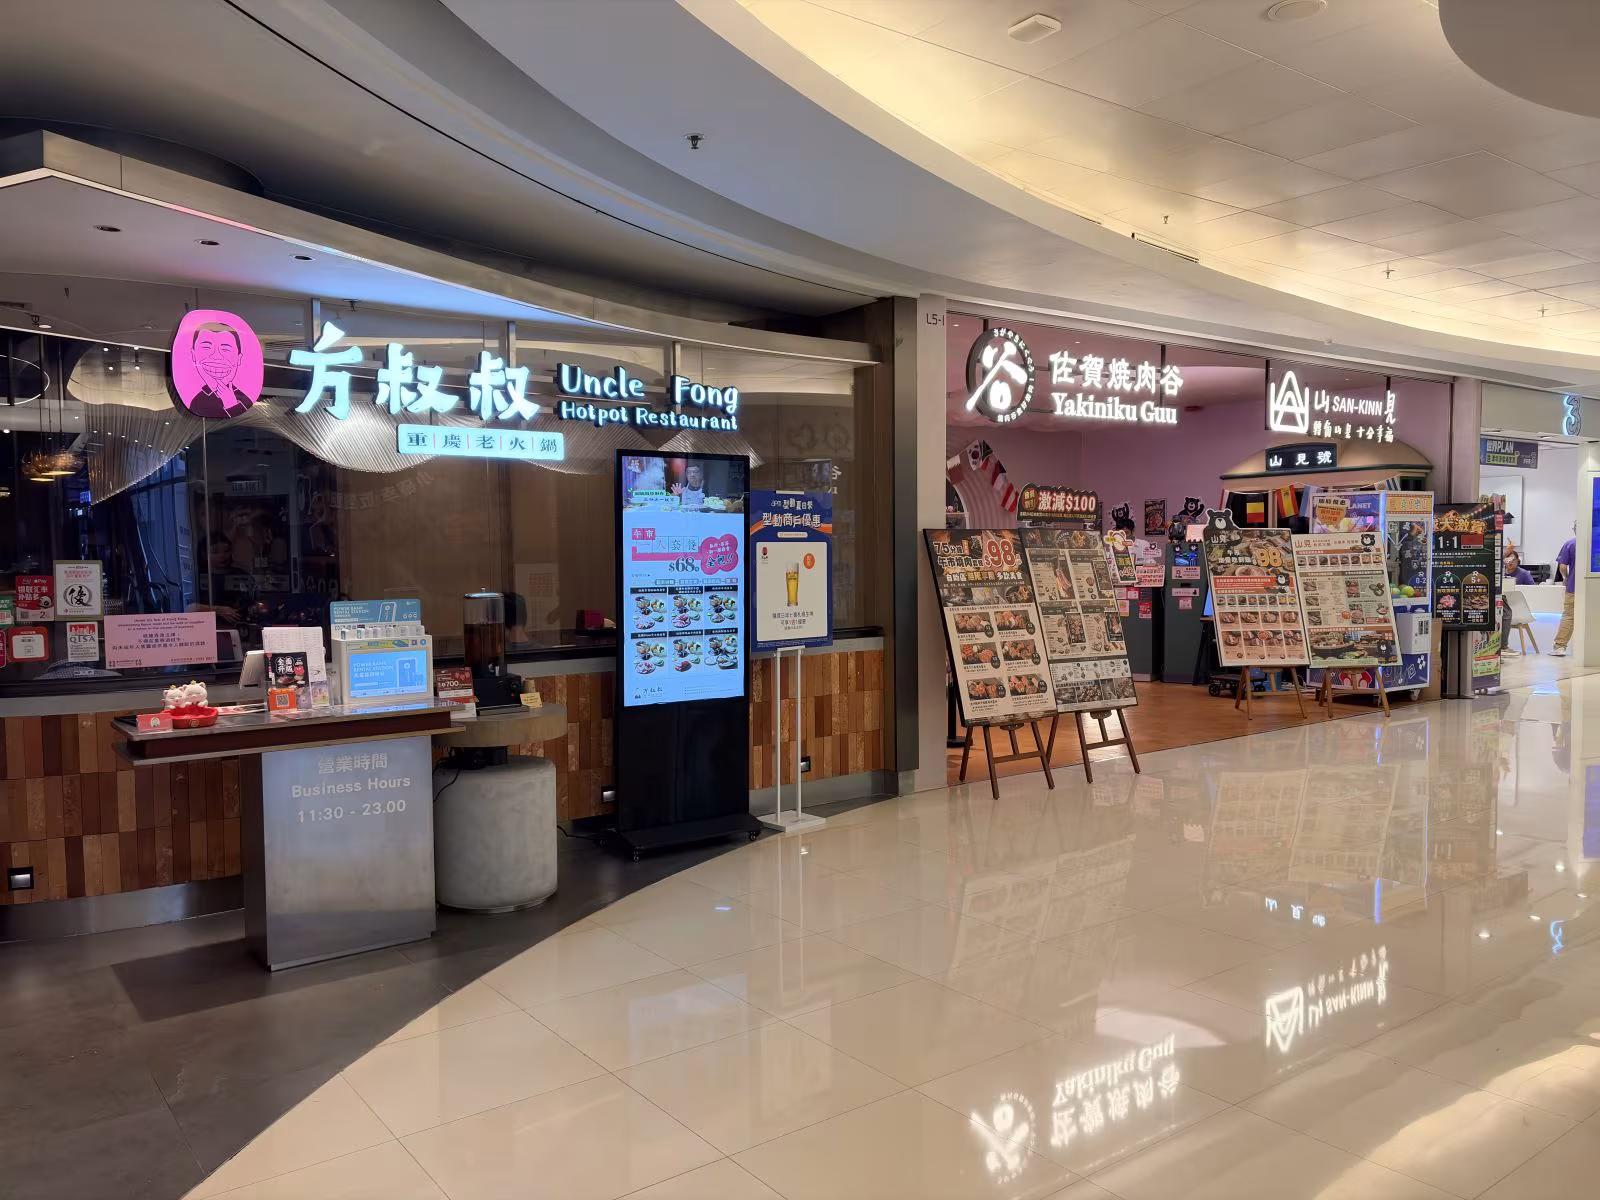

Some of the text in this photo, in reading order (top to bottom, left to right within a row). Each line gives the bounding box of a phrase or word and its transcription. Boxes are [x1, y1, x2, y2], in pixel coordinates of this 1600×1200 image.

[290, 321, 540, 421] 方叔叔
[559, 363, 739, 415] Uncle Fong
[560, 400, 738, 431] Hotpot Restaurant
[1051, 392, 1138, 420] Yakiniku
[1140, 400, 1178, 424] Guu
[1332, 396, 1383, 416] SAN-KINN
[407, 432, 558, 453] 重慶老火鍋
[1269, 450, 1333, 468] 山見號
[763, 512, 822, 529] 型動商戶優惠
[318, 752, 389, 775] 營業時間
[291, 776, 411, 799] Business Hours
[298, 806, 345, 823] 11:30
[361, 799, 407, 817] 23.00
